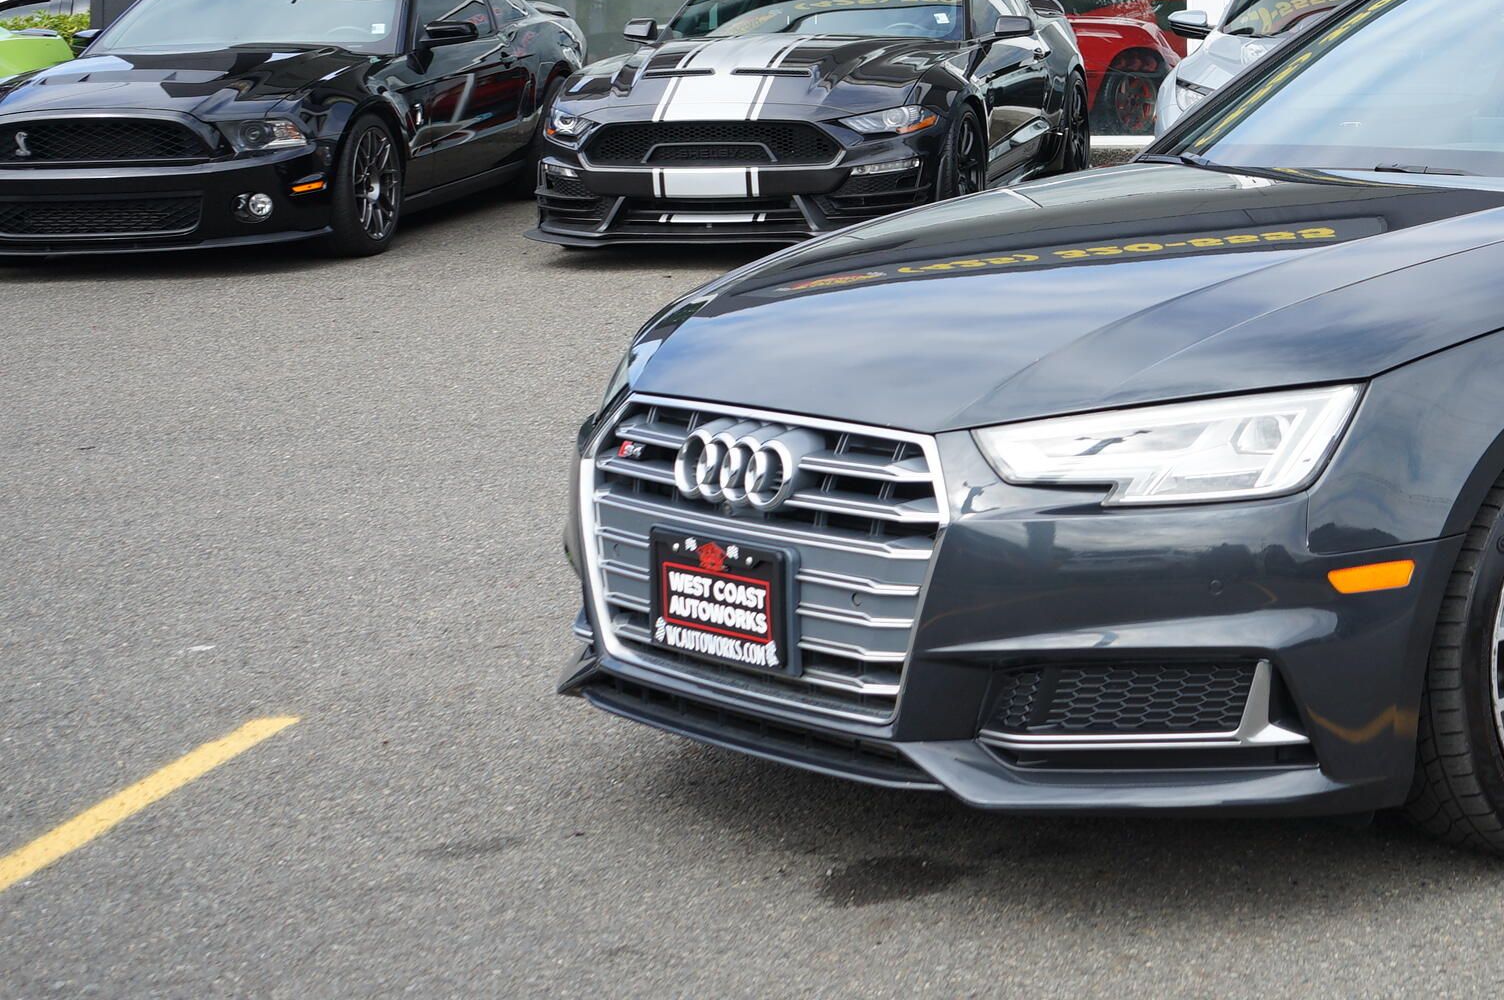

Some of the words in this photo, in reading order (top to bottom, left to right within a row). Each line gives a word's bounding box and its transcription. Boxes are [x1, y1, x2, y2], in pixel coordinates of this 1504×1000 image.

[668, 571, 712, 598] WEST
[713, 580, 766, 609] COAST
[669, 595, 768, 634] AUTOWORKS
